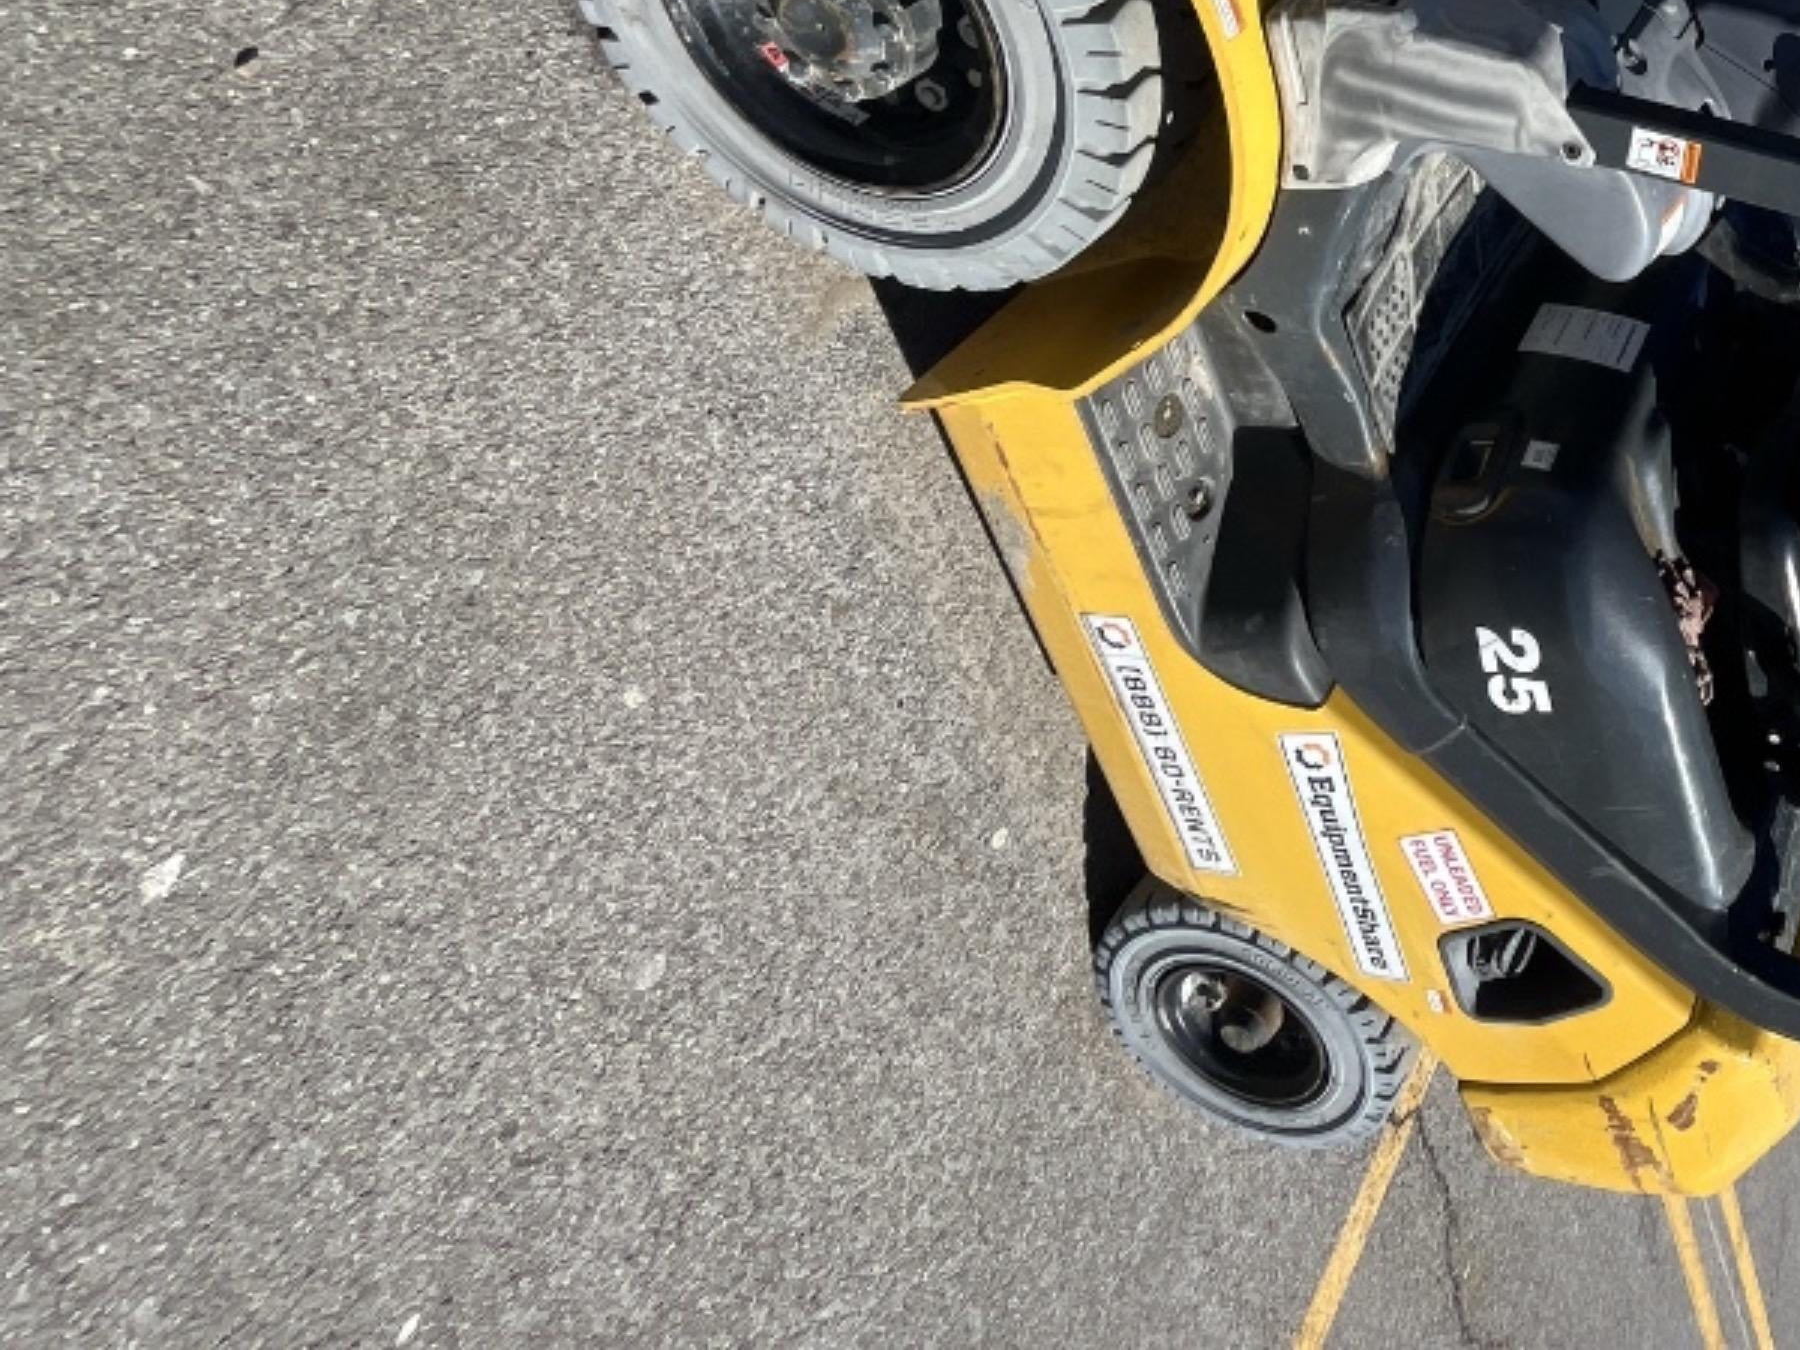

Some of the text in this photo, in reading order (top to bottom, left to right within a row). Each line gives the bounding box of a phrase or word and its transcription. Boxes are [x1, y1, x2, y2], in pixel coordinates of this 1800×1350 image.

[1475, 626, 1552, 714] 25
[1308, 776, 1387, 970] EquipmentShare
[1433, 836, 1483, 914] UNLEADED
